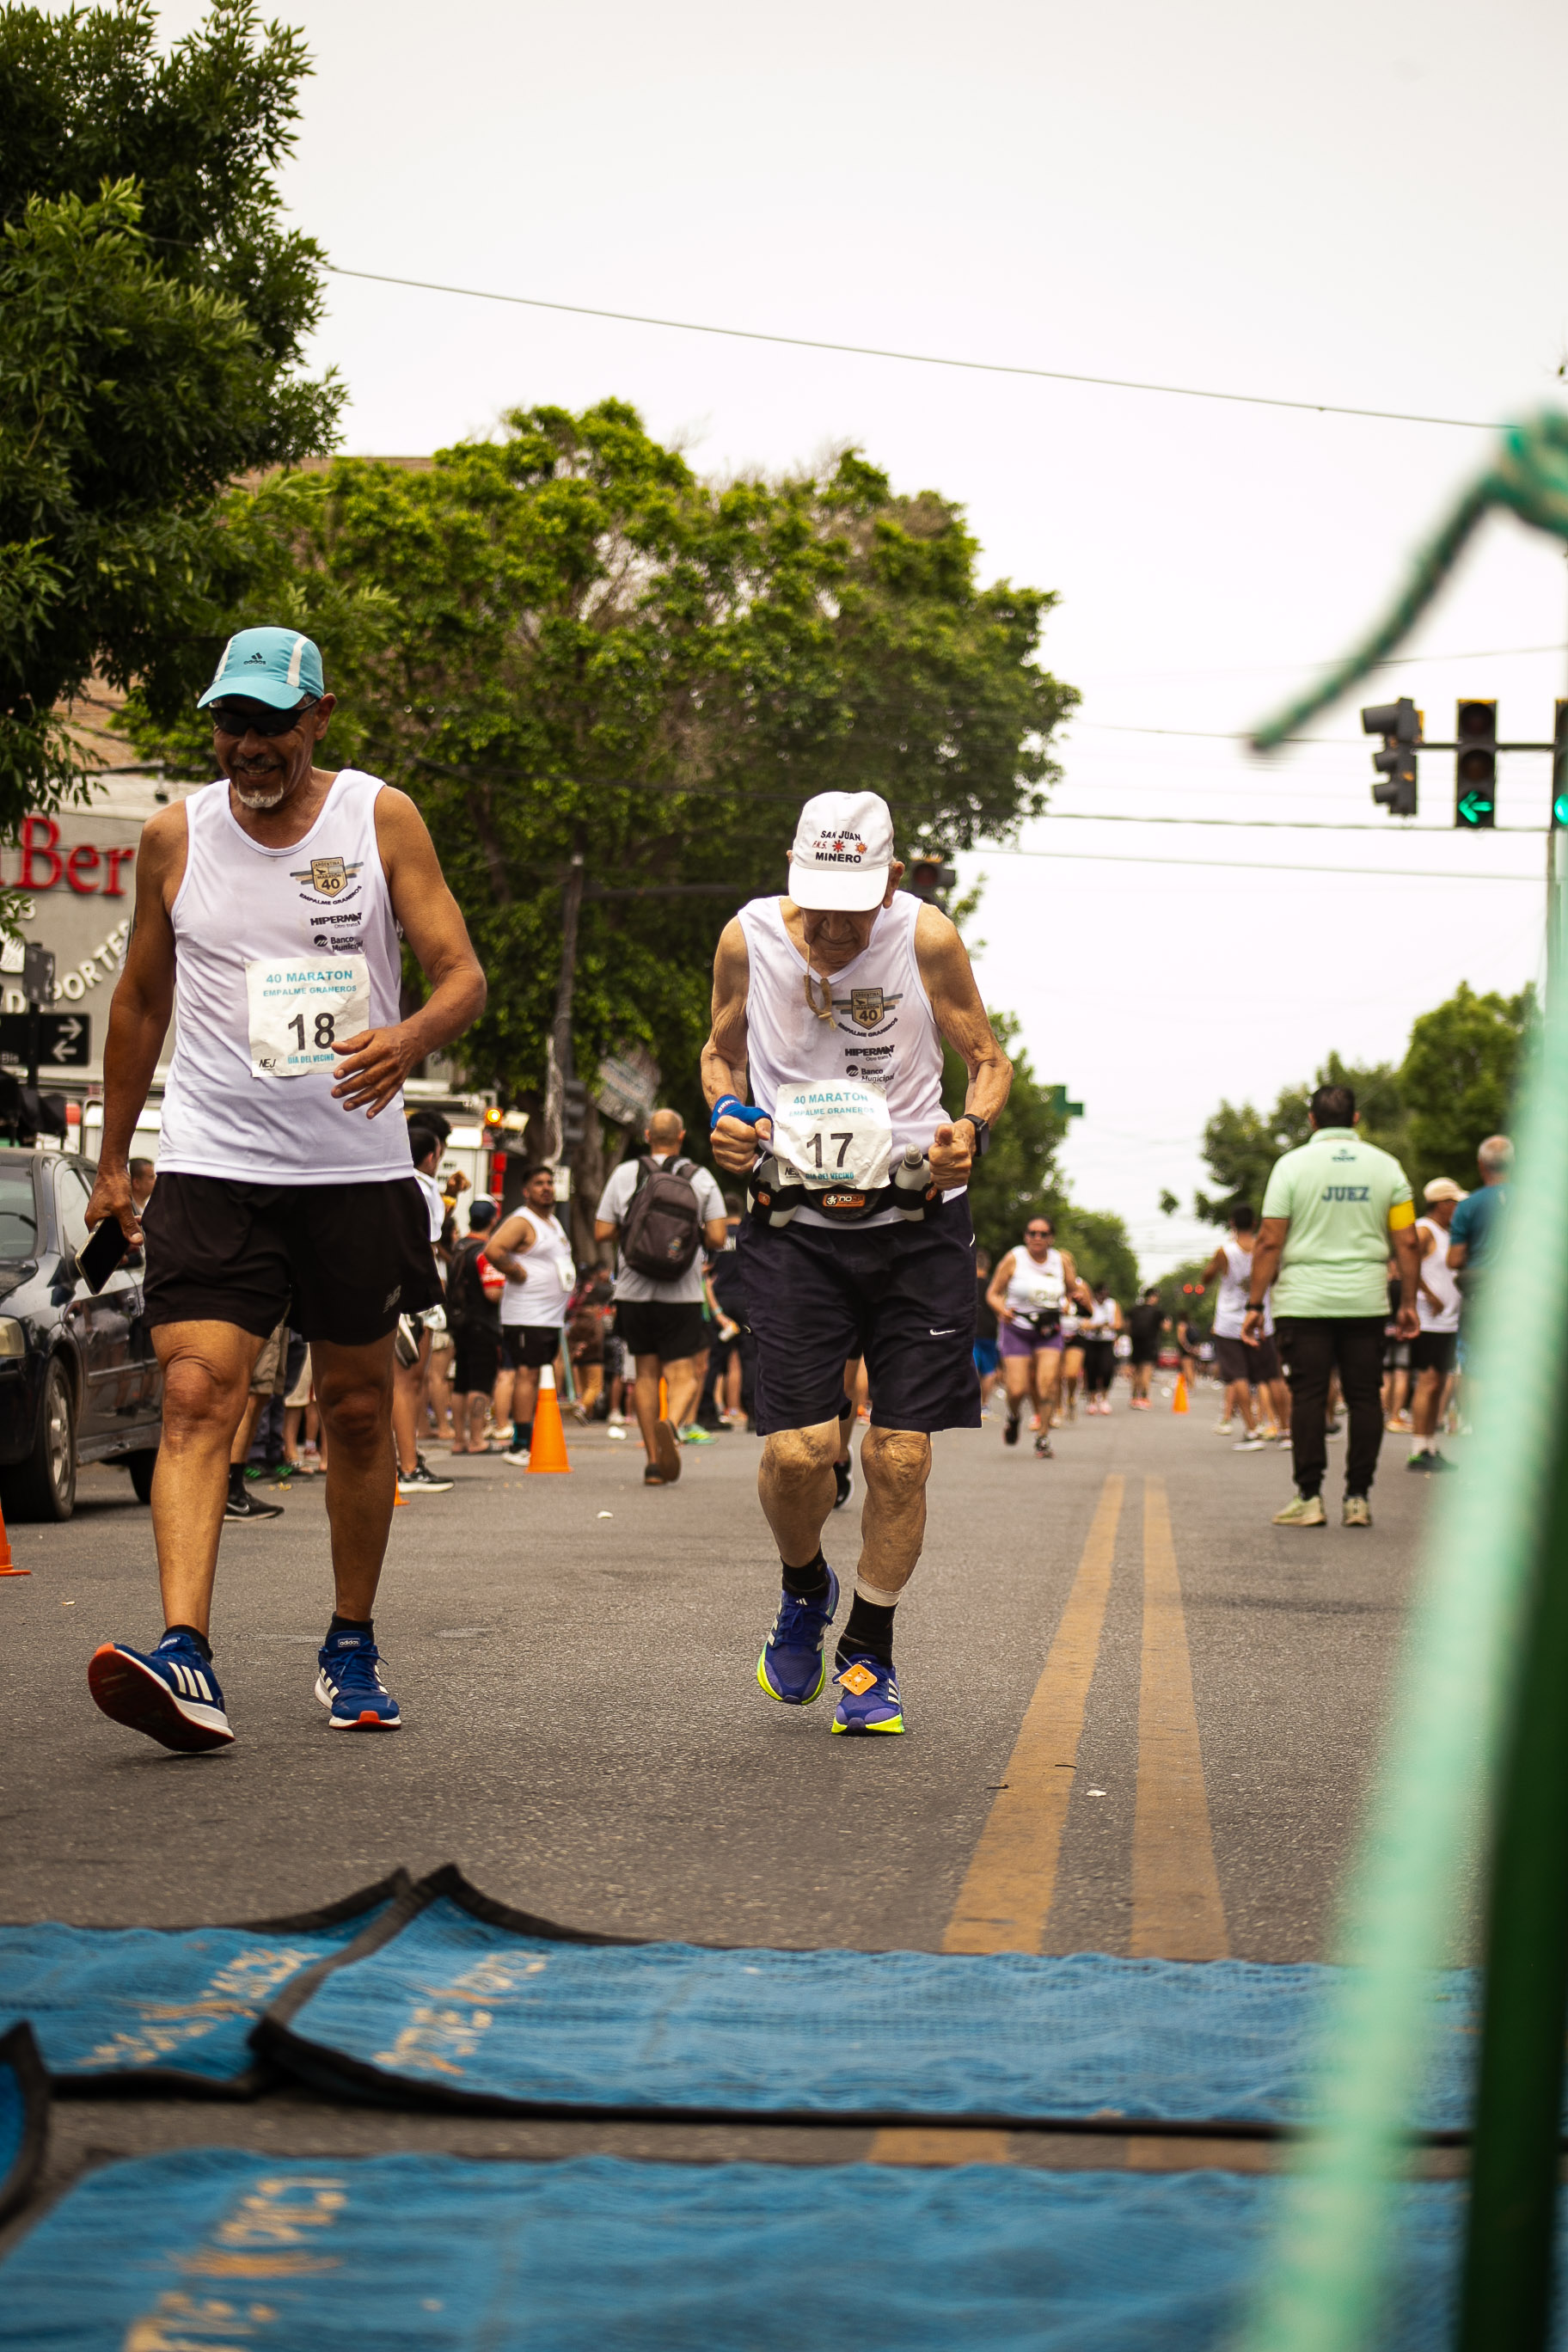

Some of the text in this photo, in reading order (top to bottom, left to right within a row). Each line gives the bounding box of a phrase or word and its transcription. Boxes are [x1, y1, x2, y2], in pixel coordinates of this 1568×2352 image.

[838, 830, 861, 842] JUAN
[815, 852, 861, 863] MINERO
[321, 879, 340, 890] 40
[298, 885, 362, 905] EMPALME GRANEROS
[330, 936, 354, 945] Banco
[266, 970, 353, 983] 40 MARATON
[263, 985, 357, 997] EMPALME GRANEROS
[859, 1009, 878, 1021] 40
[288, 1012, 335, 1051] 18
[837, 1017, 898, 1037] EMPALME GRANEROS
[259, 1058, 277, 1069] NEJ
[287, 1053, 334, 1064] DIA DEL VECINO
[861, 1073, 895, 1083] Municipal
[793, 1092, 868, 1105] 40 MARATON
[789, 1106, 874, 1117] EMPALME GRANEROS
[806, 1132, 854, 1168] 17
[830, 1172, 854, 1180] VECINO
[1321, 1186, 1369, 1202] JUEZ
